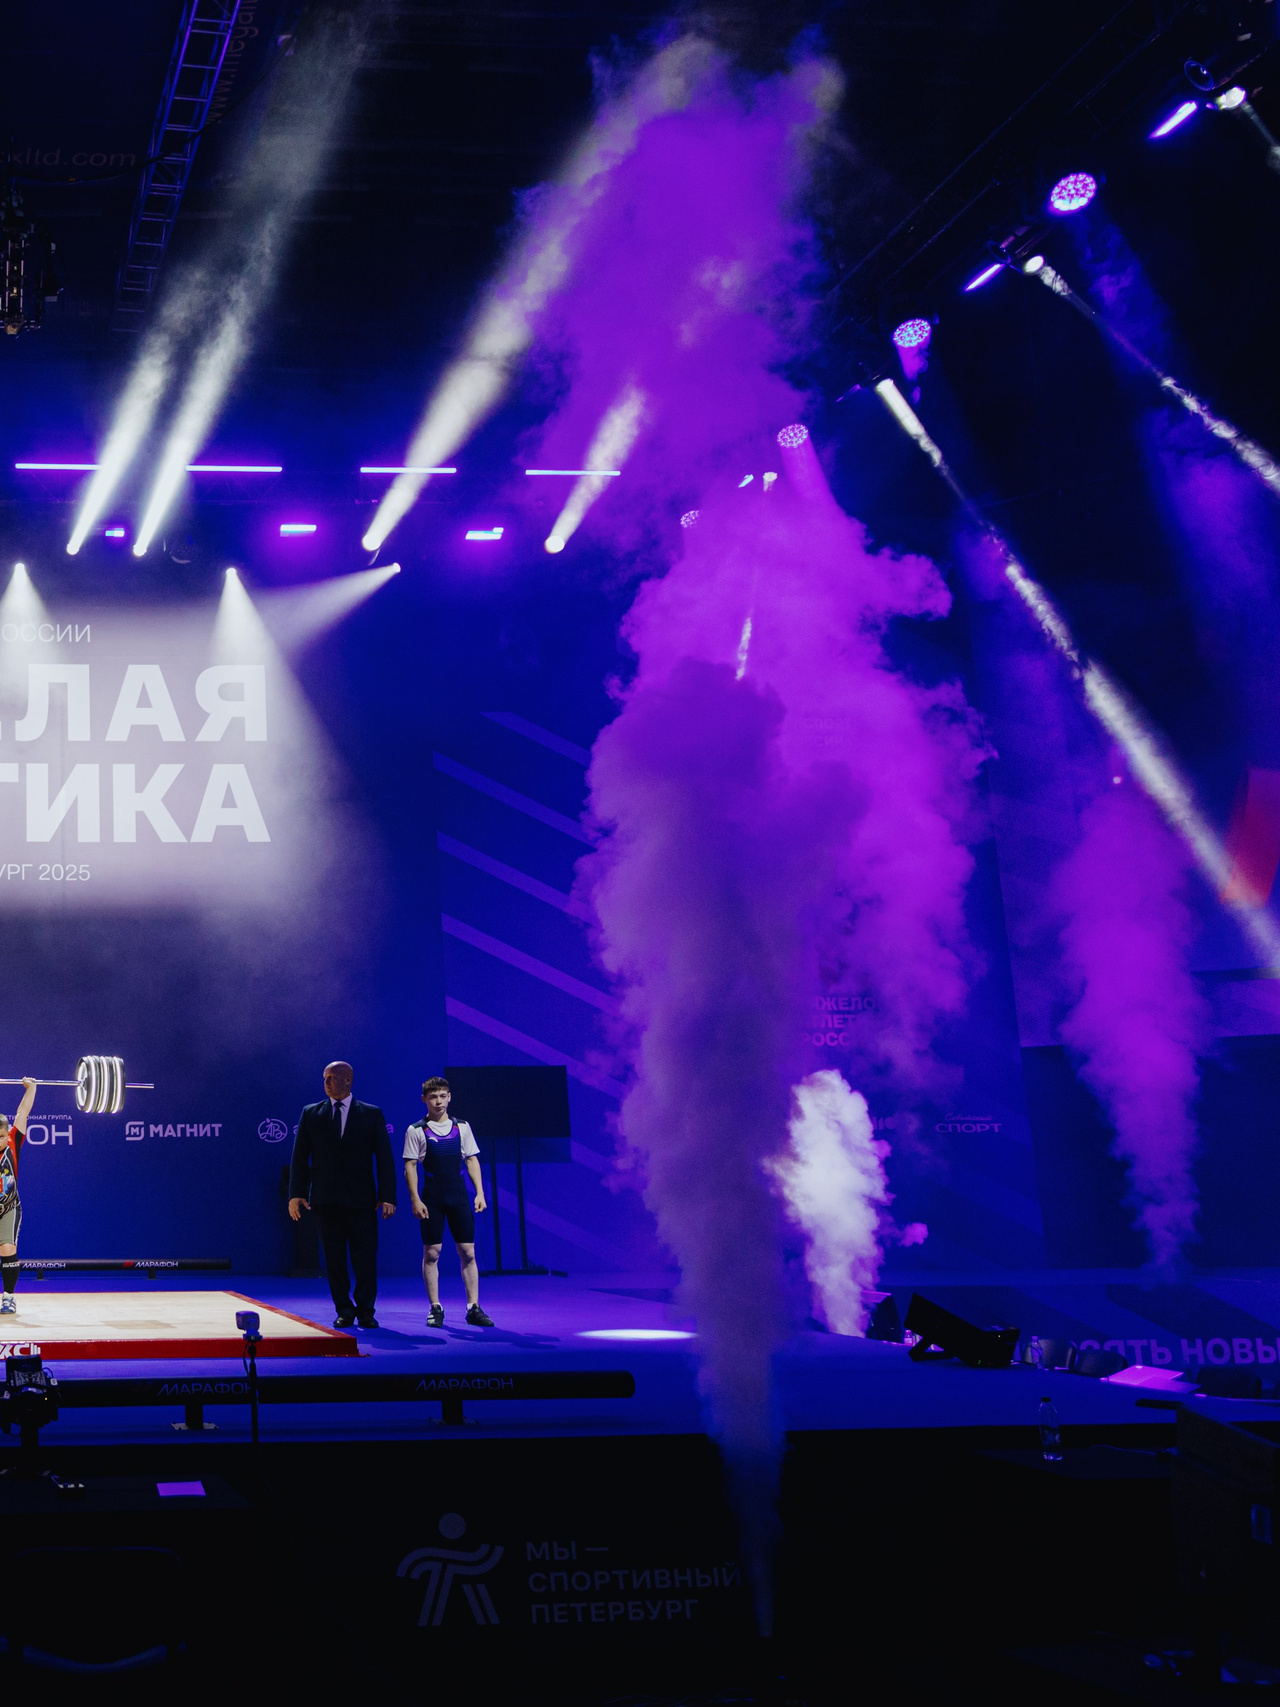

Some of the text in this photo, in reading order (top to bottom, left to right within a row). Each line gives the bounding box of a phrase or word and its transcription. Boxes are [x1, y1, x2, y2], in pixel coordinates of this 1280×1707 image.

[38, 862, 91, 882] 2025
[149, 1123, 222, 1138] МАГНИТ
[935, 1123, 1002, 1133] СПОРТ
[415, 1376, 515, 1391] МАРАФОН
[526, 1540, 578, 1561] МЫ
[527, 1562, 742, 1594] СПОРТИВНЫЙ
[531, 1599, 699, 1625] ПЕТЕРБУРГ
